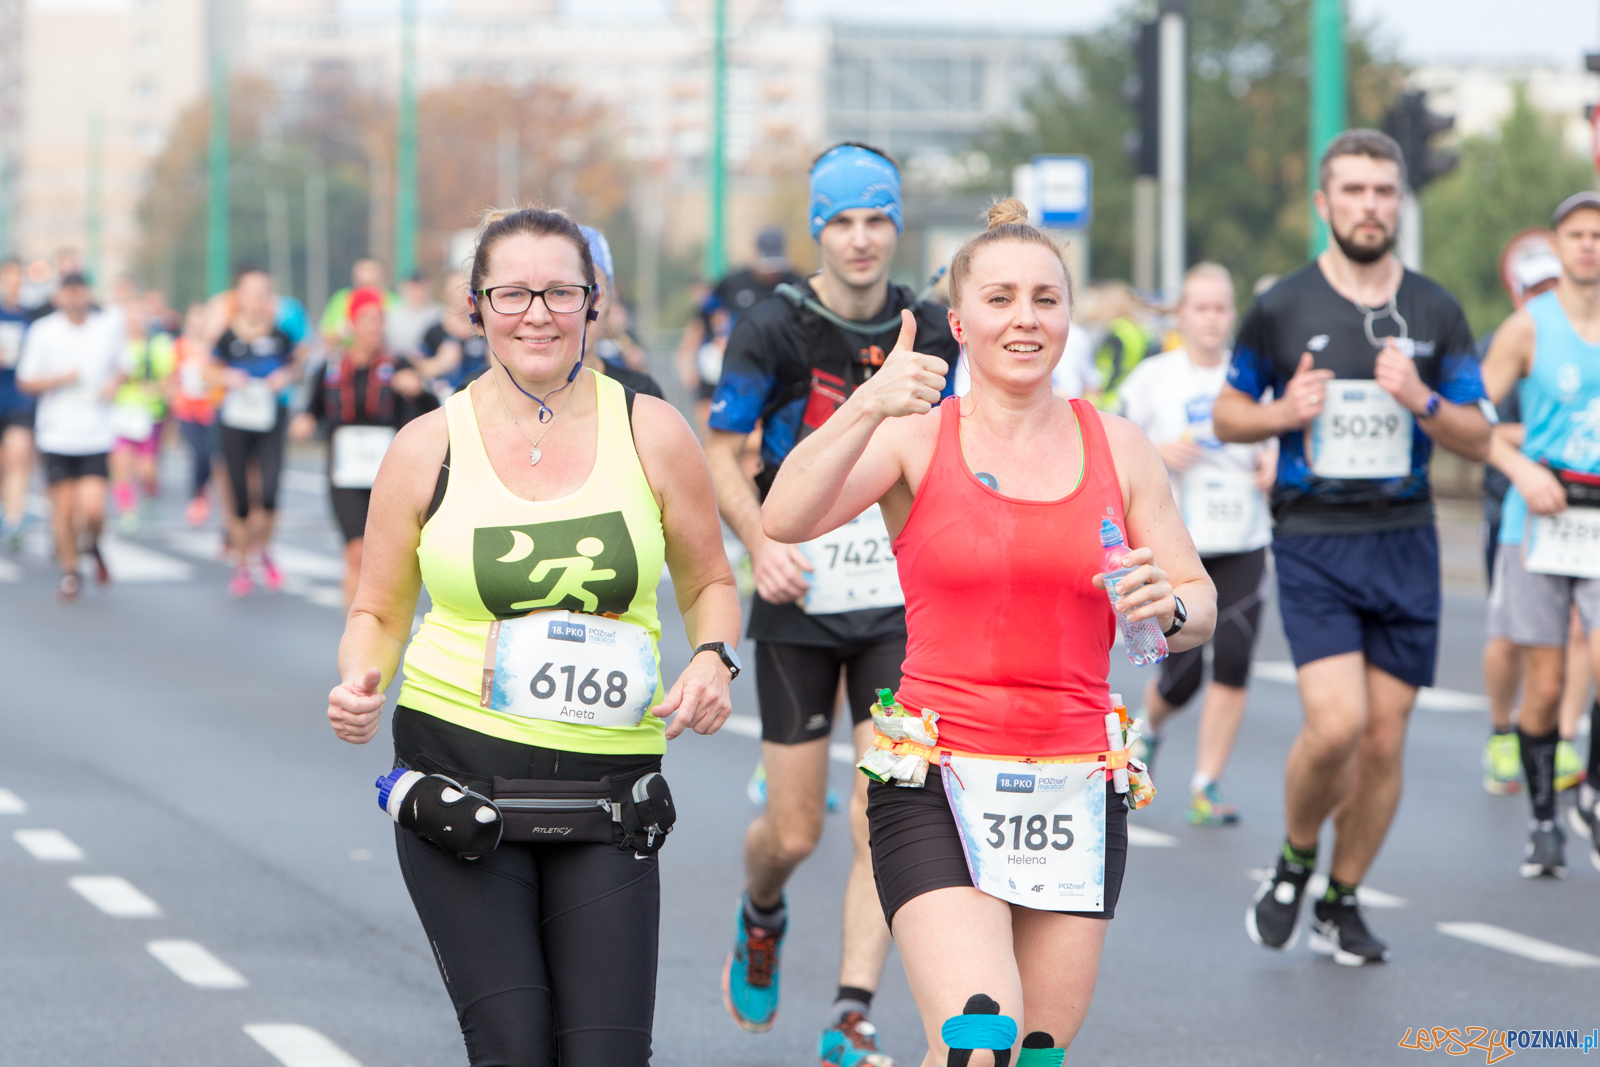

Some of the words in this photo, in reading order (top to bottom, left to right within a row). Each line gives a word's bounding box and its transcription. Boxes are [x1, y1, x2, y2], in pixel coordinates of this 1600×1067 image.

[1332, 414, 1400, 439] 5029
[551, 625, 565, 635] 18.
[565, 626, 584, 638] PKO
[588, 635, 616, 645] maraton
[529, 661, 628, 709] 6168
[559, 706, 595, 720] Aneta
[1000, 778, 1012, 788] 18.
[1013, 779, 1033, 789] PKO
[1037, 783, 1065, 791] maraton
[982, 812, 1074, 851] 3185
[1007, 854, 1047, 865] Helena
